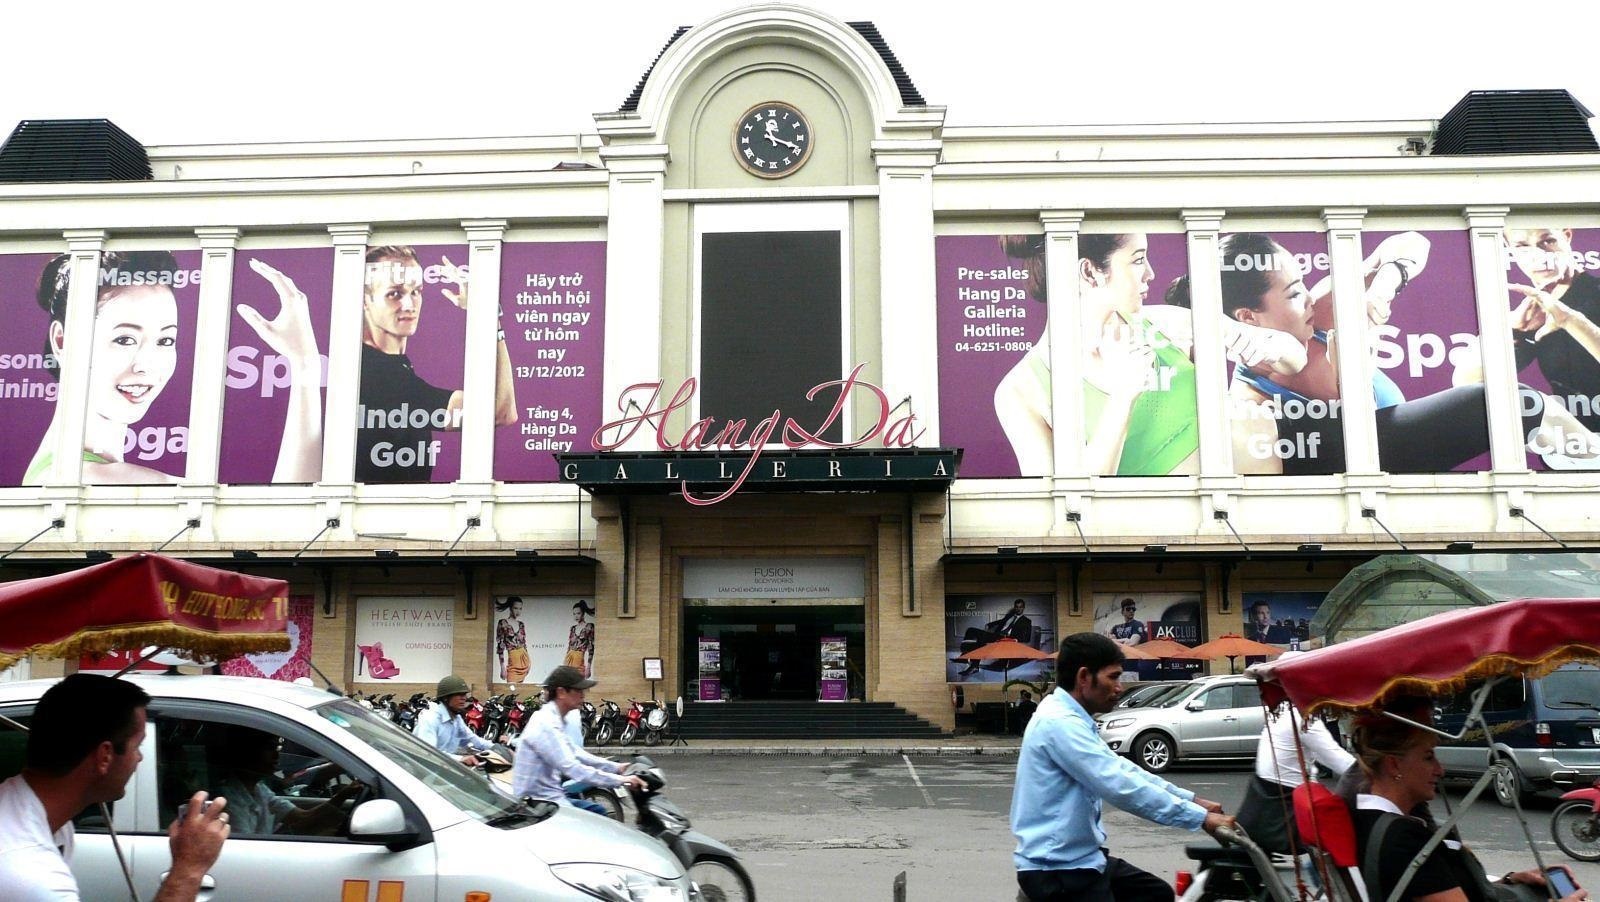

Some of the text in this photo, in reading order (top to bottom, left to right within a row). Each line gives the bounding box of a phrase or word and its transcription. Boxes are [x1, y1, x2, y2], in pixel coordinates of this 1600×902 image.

[98, 267, 202, 288] Massage
[526, 272, 583, 290] Hãy trở
[958, 266, 1029, 280] Pre-sales
[516, 291, 590, 307] thành hội
[958, 286, 1026, 303] Hang Da
[515, 310, 590, 326] viên ngay
[964, 304, 1026, 318] Galleria
[524, 327, 580, 341] từ hôm
[963, 323, 1025, 337] Hotline:
[537, 348, 566, 362] nay
[955, 342, 1032, 352] 04-6251-0808
[1376, 324, 1480, 377] Spa
[226, 345, 328, 398] Sp
[516, 366, 585, 378] 13/12/2012
[358, 402, 463, 429] Indoor
[526, 405, 573, 421] Tầng 4,
[521, 423, 577, 437] Hàng Da
[591, 362, 927, 506] Hang Da
[124, 426, 188, 461] oga
[525, 438, 573, 452] Gallery
[1247, 432, 1320, 459] Golf
[370, 440, 441, 467] Golf
[564, 459, 947, 480] GALLERIA
[754, 567, 794, 577] FUSION
[371, 609, 452, 621] HEATWAVE
